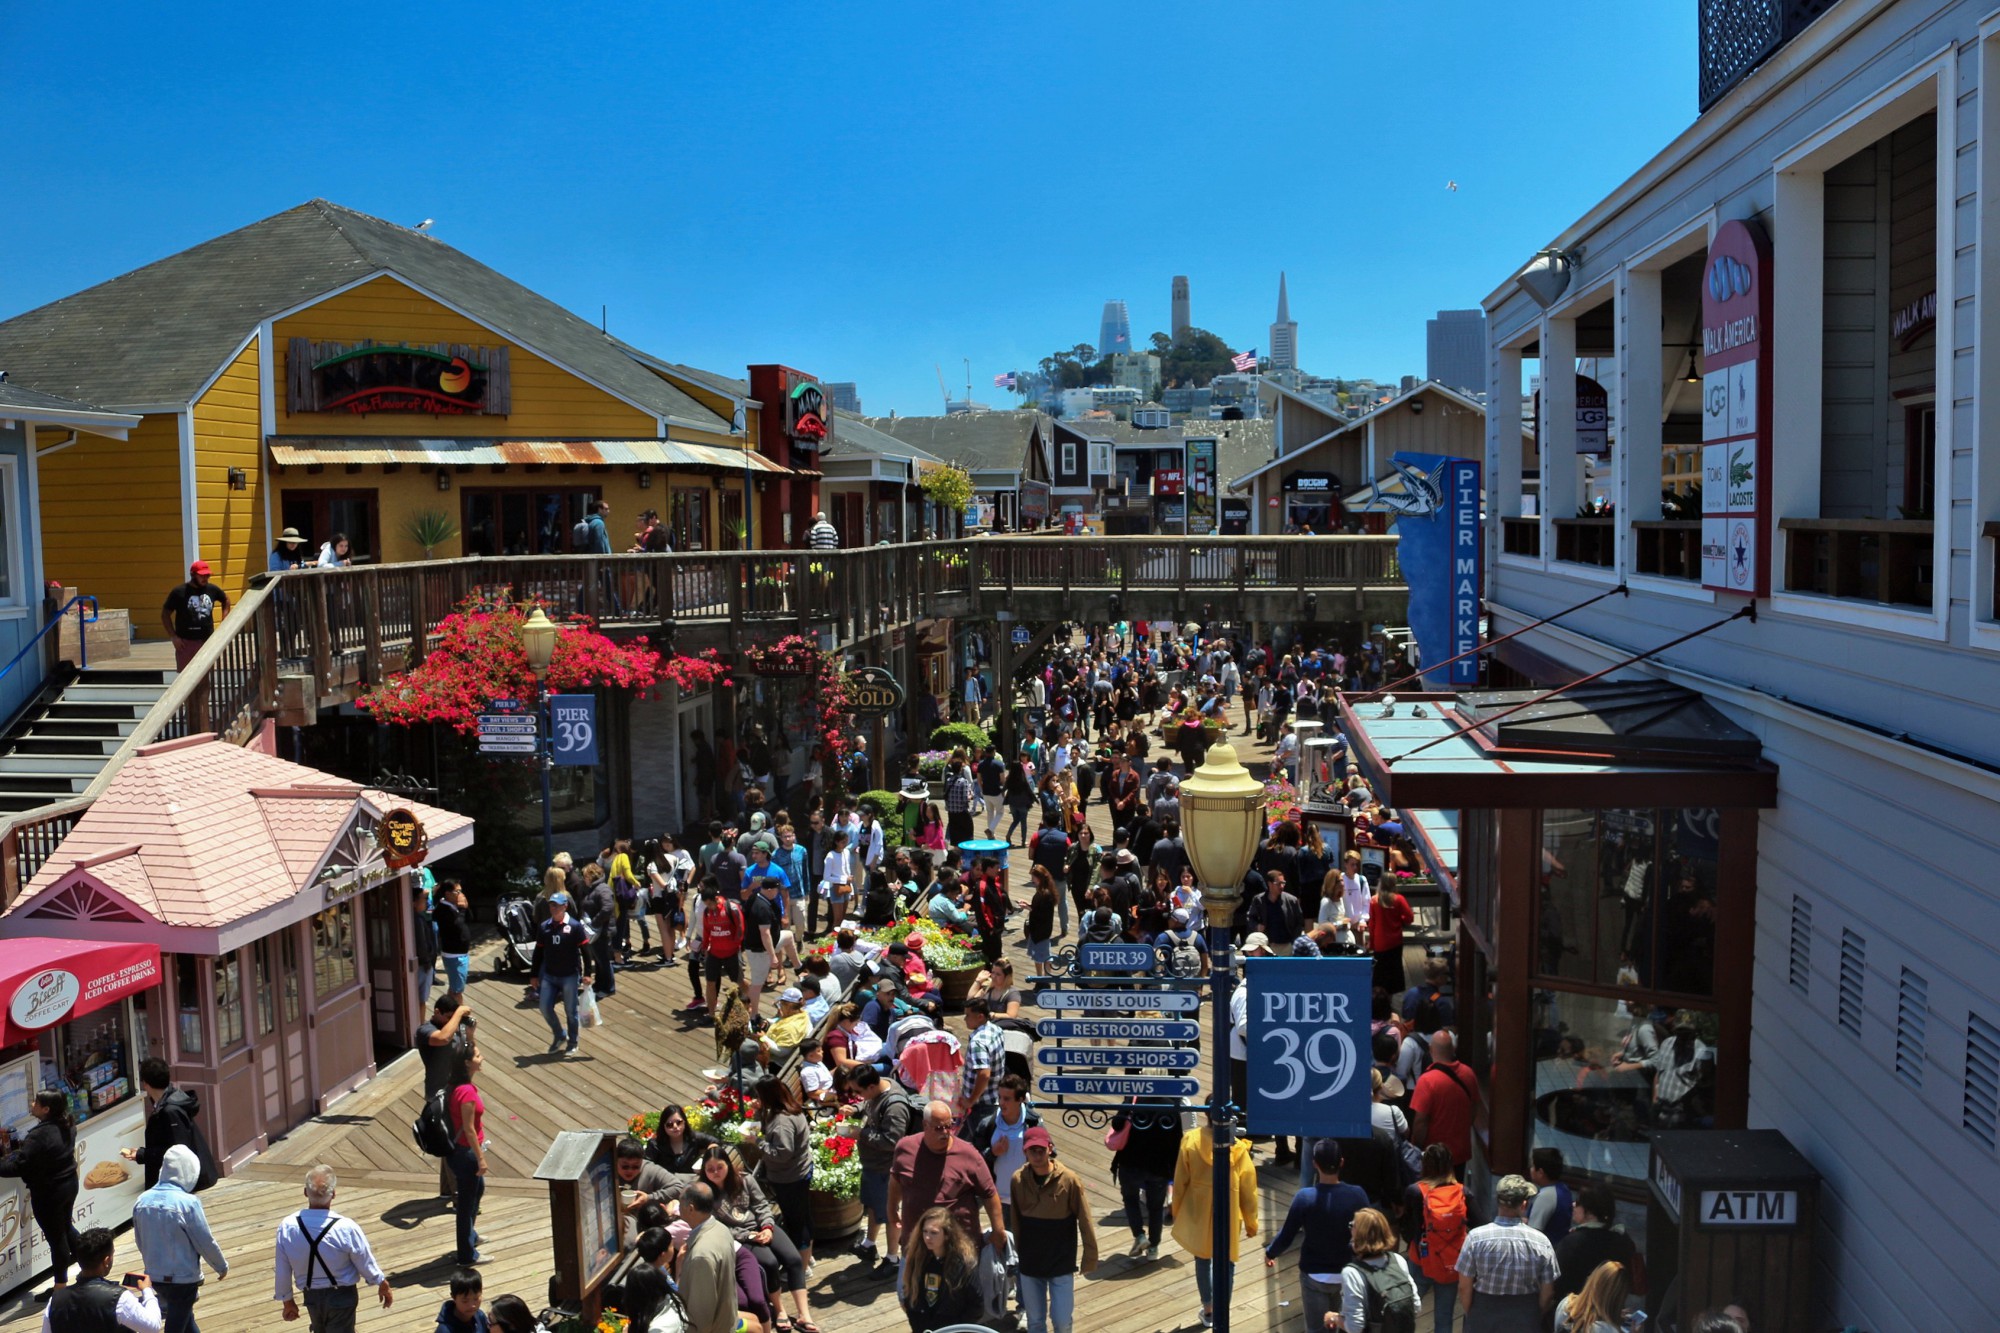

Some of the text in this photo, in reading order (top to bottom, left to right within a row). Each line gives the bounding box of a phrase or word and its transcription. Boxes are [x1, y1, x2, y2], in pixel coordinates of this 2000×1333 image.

[1893, 300, 1919, 339] WALK
[1703, 314, 1756, 357] WALK AMERICA
[347, 397, 464, 416] The Flavor of Mexico
[1705, 385, 1726, 418] UGG
[1576, 411, 1604, 424] UGG
[1167, 472, 1181, 481] NFL
[1706, 466, 1722, 482] TOMS
[1729, 491, 1754, 506] LACOSTE
[1456, 469, 1475, 676] PIER MARKET
[779, 664, 800, 672] WEAR
[848, 691, 896, 706] GOLD
[556, 708, 590, 721] PIER
[556, 722, 592, 752] 39
[1321, 804, 1342, 812] MARKET
[388, 820, 415, 831] Charms
[394, 836, 412, 847] Bay
[552, 935, 560, 944] 10
[1088, 951, 1146, 966] PIER 39
[88, 959, 152, 990] COFFEE ESPRESSO
[84, 966, 156, 1000] ICED COFFEE DRINKS
[24, 973, 66, 1017] Biscoff
[1066, 995, 1161, 1008] SWISS LOUIS
[24, 1000, 70, 1022] COFFEE CART
[1261, 992, 1353, 1023] PIER
[1072, 1024, 1164, 1036] RESTROOMS
[1065, 1052, 1177, 1066] LEVEL 2 SHOPS
[1258, 1028, 1357, 1101] 39
[1075, 1080, 1154, 1094] BAY VIEWS
[1709, 1192, 1784, 1220] ATM
[16, 1252, 42, 1272] favorite
